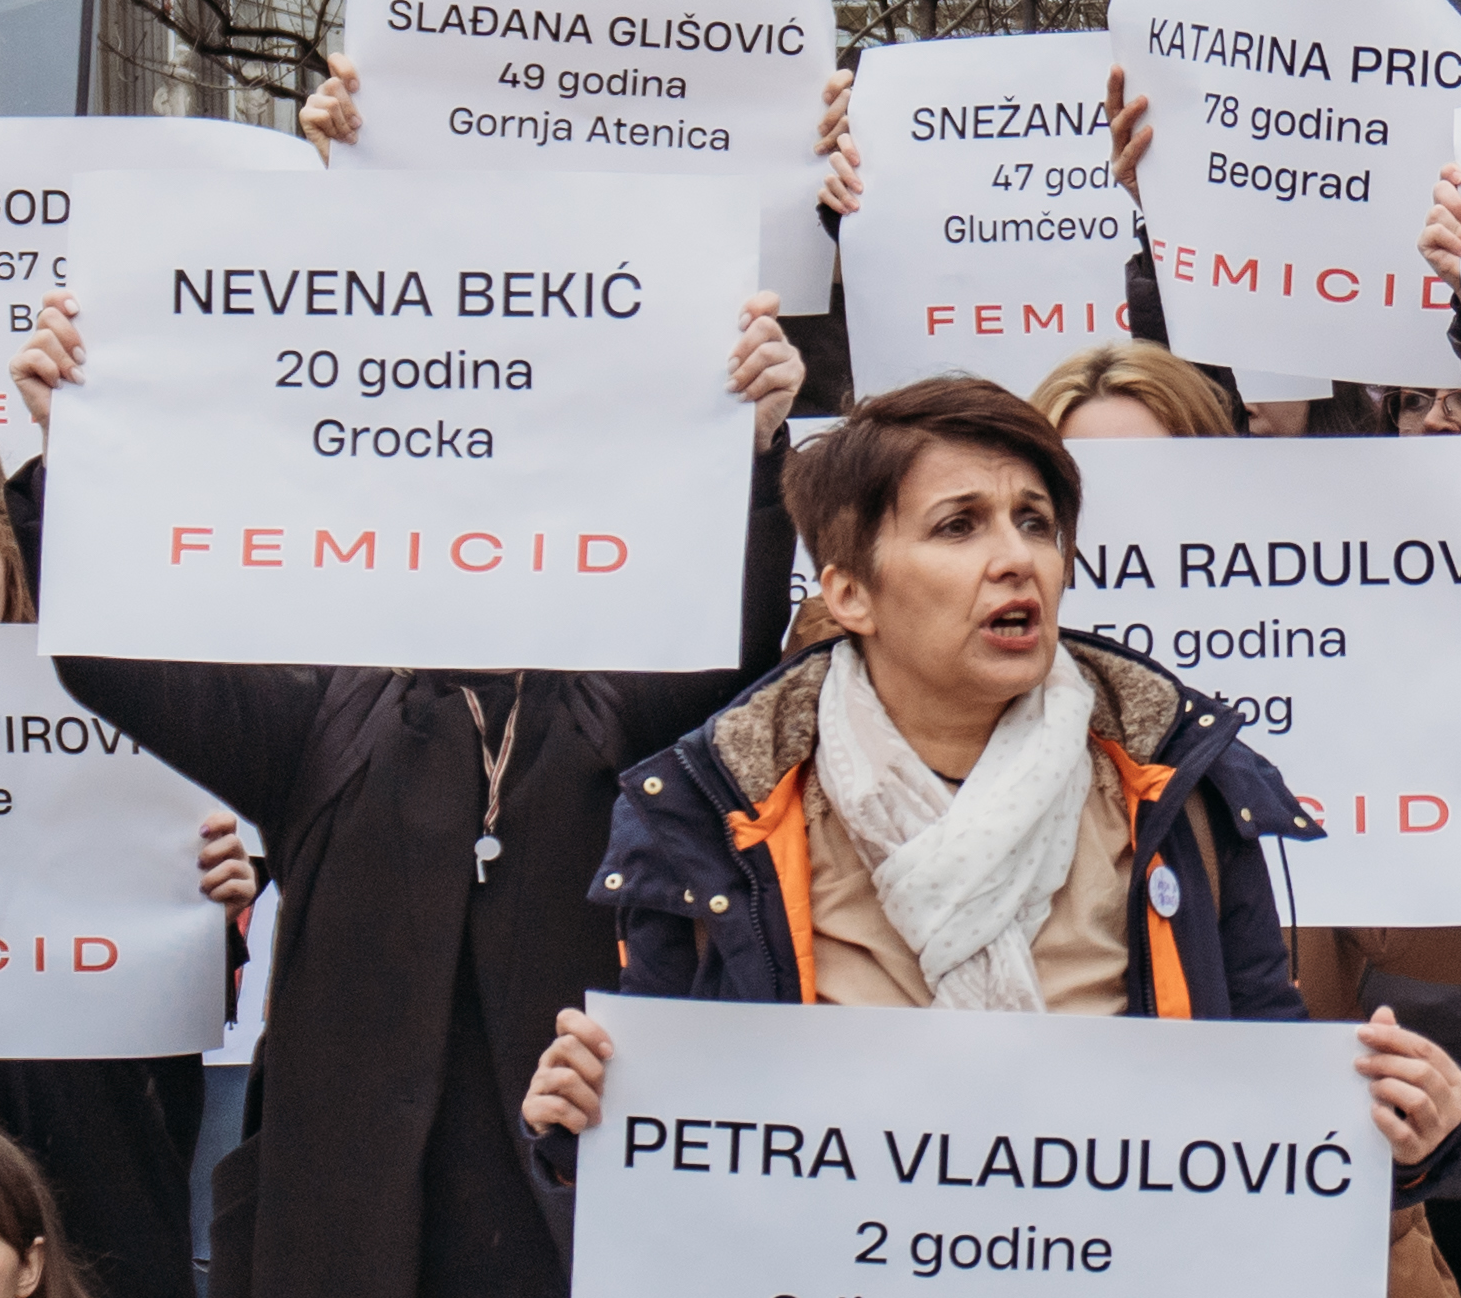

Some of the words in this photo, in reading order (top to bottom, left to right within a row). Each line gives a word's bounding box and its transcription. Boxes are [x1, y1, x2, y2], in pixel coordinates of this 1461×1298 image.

[389, 0, 592, 44] SLAĐANA
[609, 14, 804, 55] GLIŠOVIĆ
[1150, 18, 1331, 80] KATARINA
[499, 63, 544, 90] 49
[559, 69, 686, 99] godina
[450, 107, 572, 146] Gornja
[586, 116, 729, 151] Atenica
[1205, 93, 1238, 128] 78
[1252, 107, 1388, 145] godina
[992, 164, 1033, 190] 47
[1209, 152, 1370, 202] Beograd
[944, 211, 1118, 244] Glumčevo
[174, 270, 432, 316] NEVENA
[459, 262, 641, 319] BEKIĆ
[276, 350, 338, 388] 20
[359, 350, 531, 398] godina
[314, 419, 492, 458] Grocka
[172, 528, 627, 572] FEMICID
[1174, 619, 1345, 669] godina
[625, 1116, 856, 1180] PETRA
[884, 1131, 1351, 1197] VLADULOVIĆ
[855, 1222, 887, 1264] 2
[911, 1226, 1111, 1278] godine
